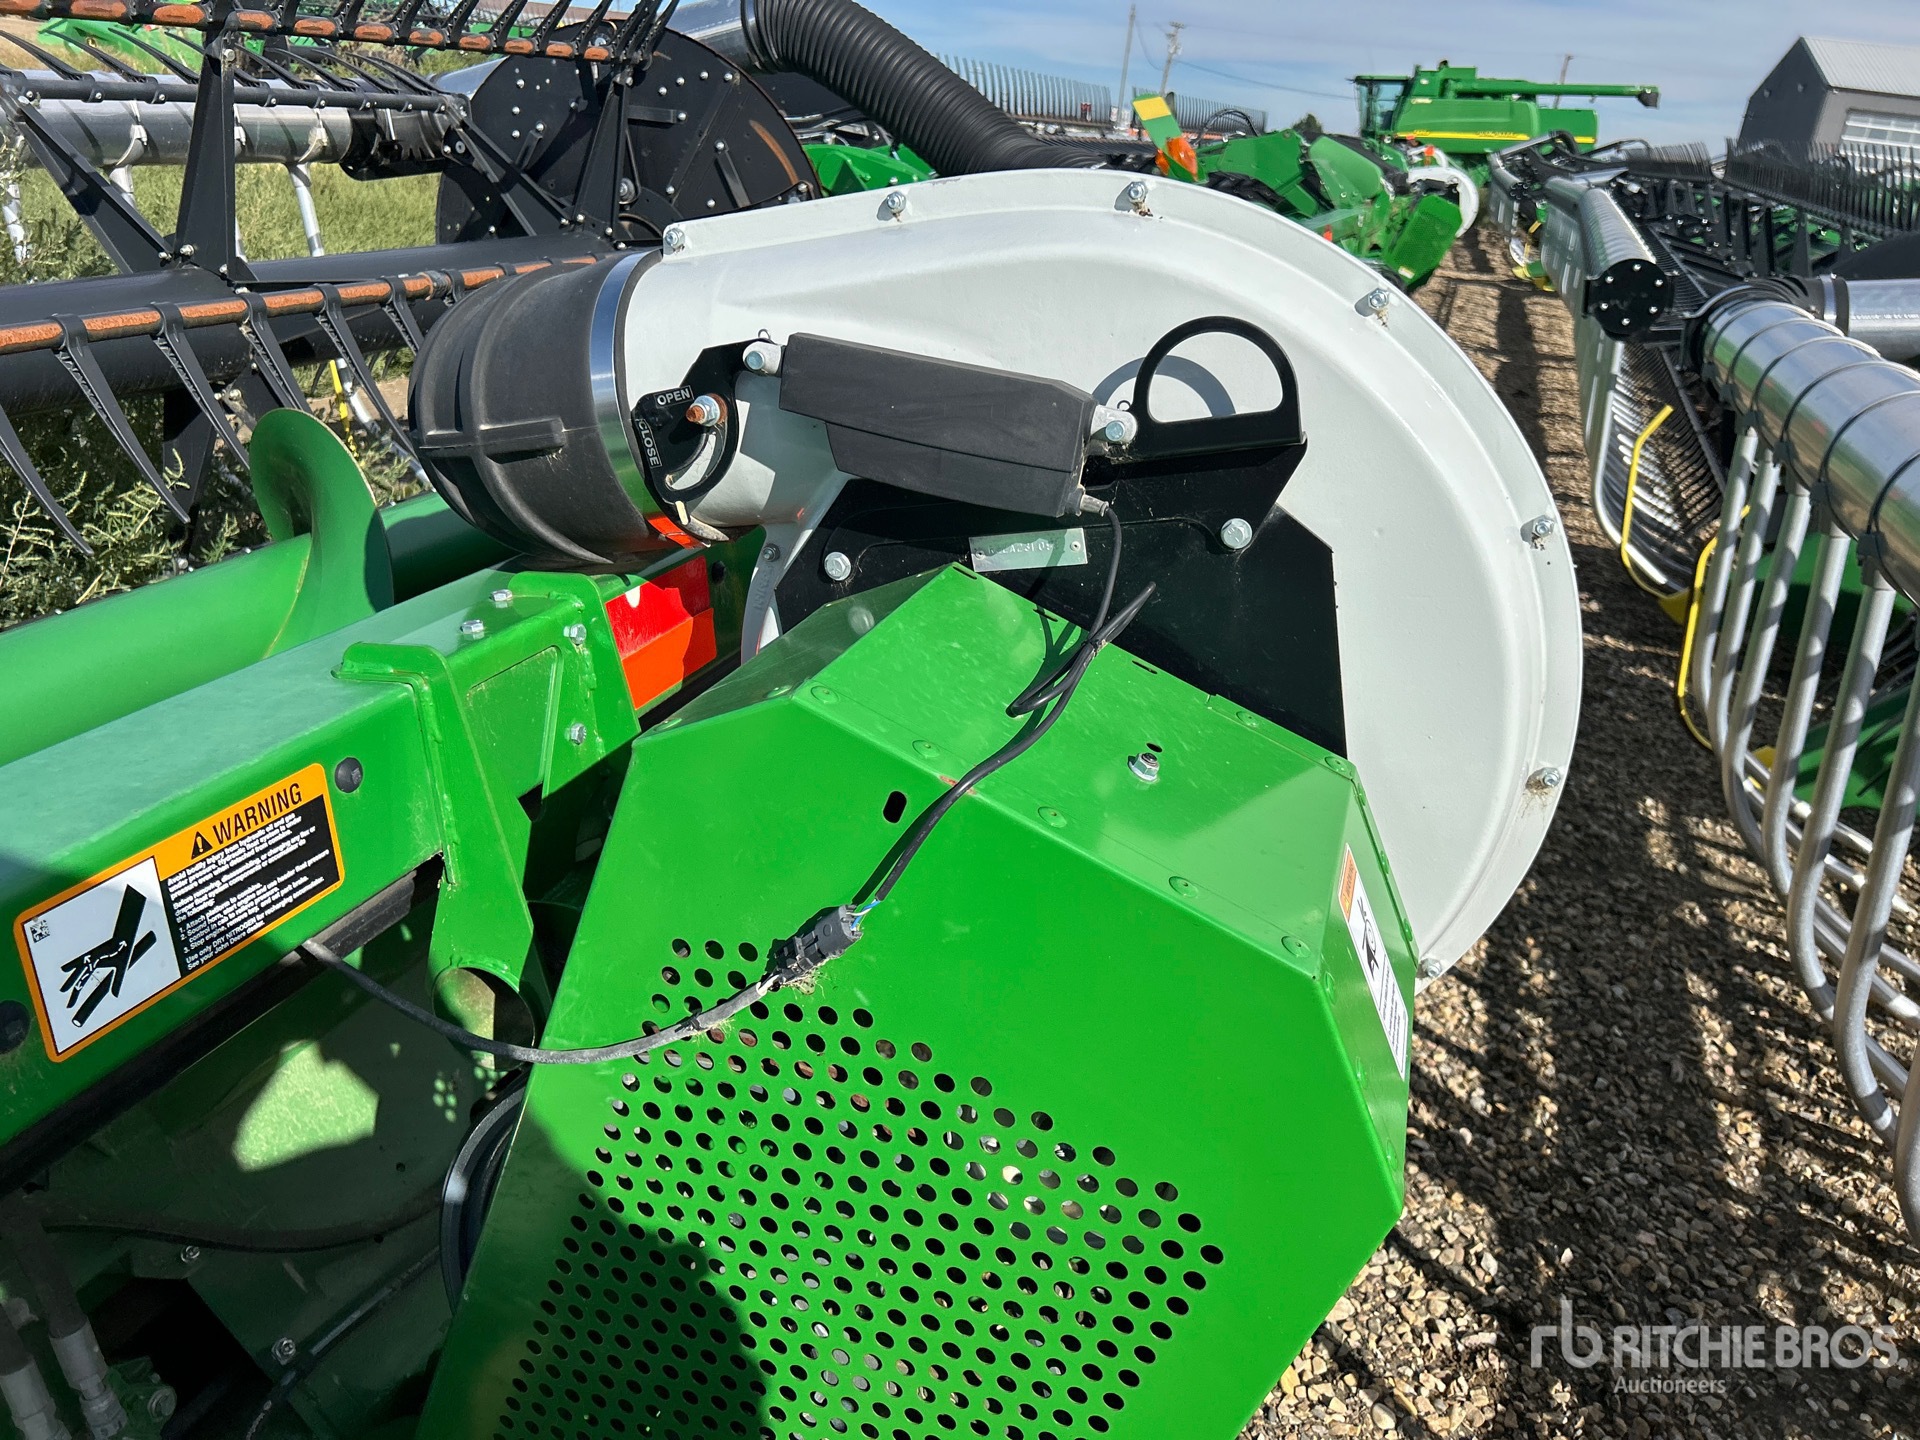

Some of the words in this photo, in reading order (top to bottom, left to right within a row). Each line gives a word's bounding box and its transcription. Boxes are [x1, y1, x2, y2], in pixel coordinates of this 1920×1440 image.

[657, 388, 691, 405] OPEN
[638, 421, 660, 466] CLOSE
[212, 782, 302, 845] WARNING
[186, 915, 205, 929] Attach
[187, 921, 206, 936] Sound
[189, 926, 210, 942] control
[199, 945, 211, 955] only
[226, 917, 256, 939] NITROGEN
[190, 938, 204, 949] Stop
[200, 951, 213, 964] your
[215, 942, 229, 953] John
[230, 932, 246, 944] Deere
